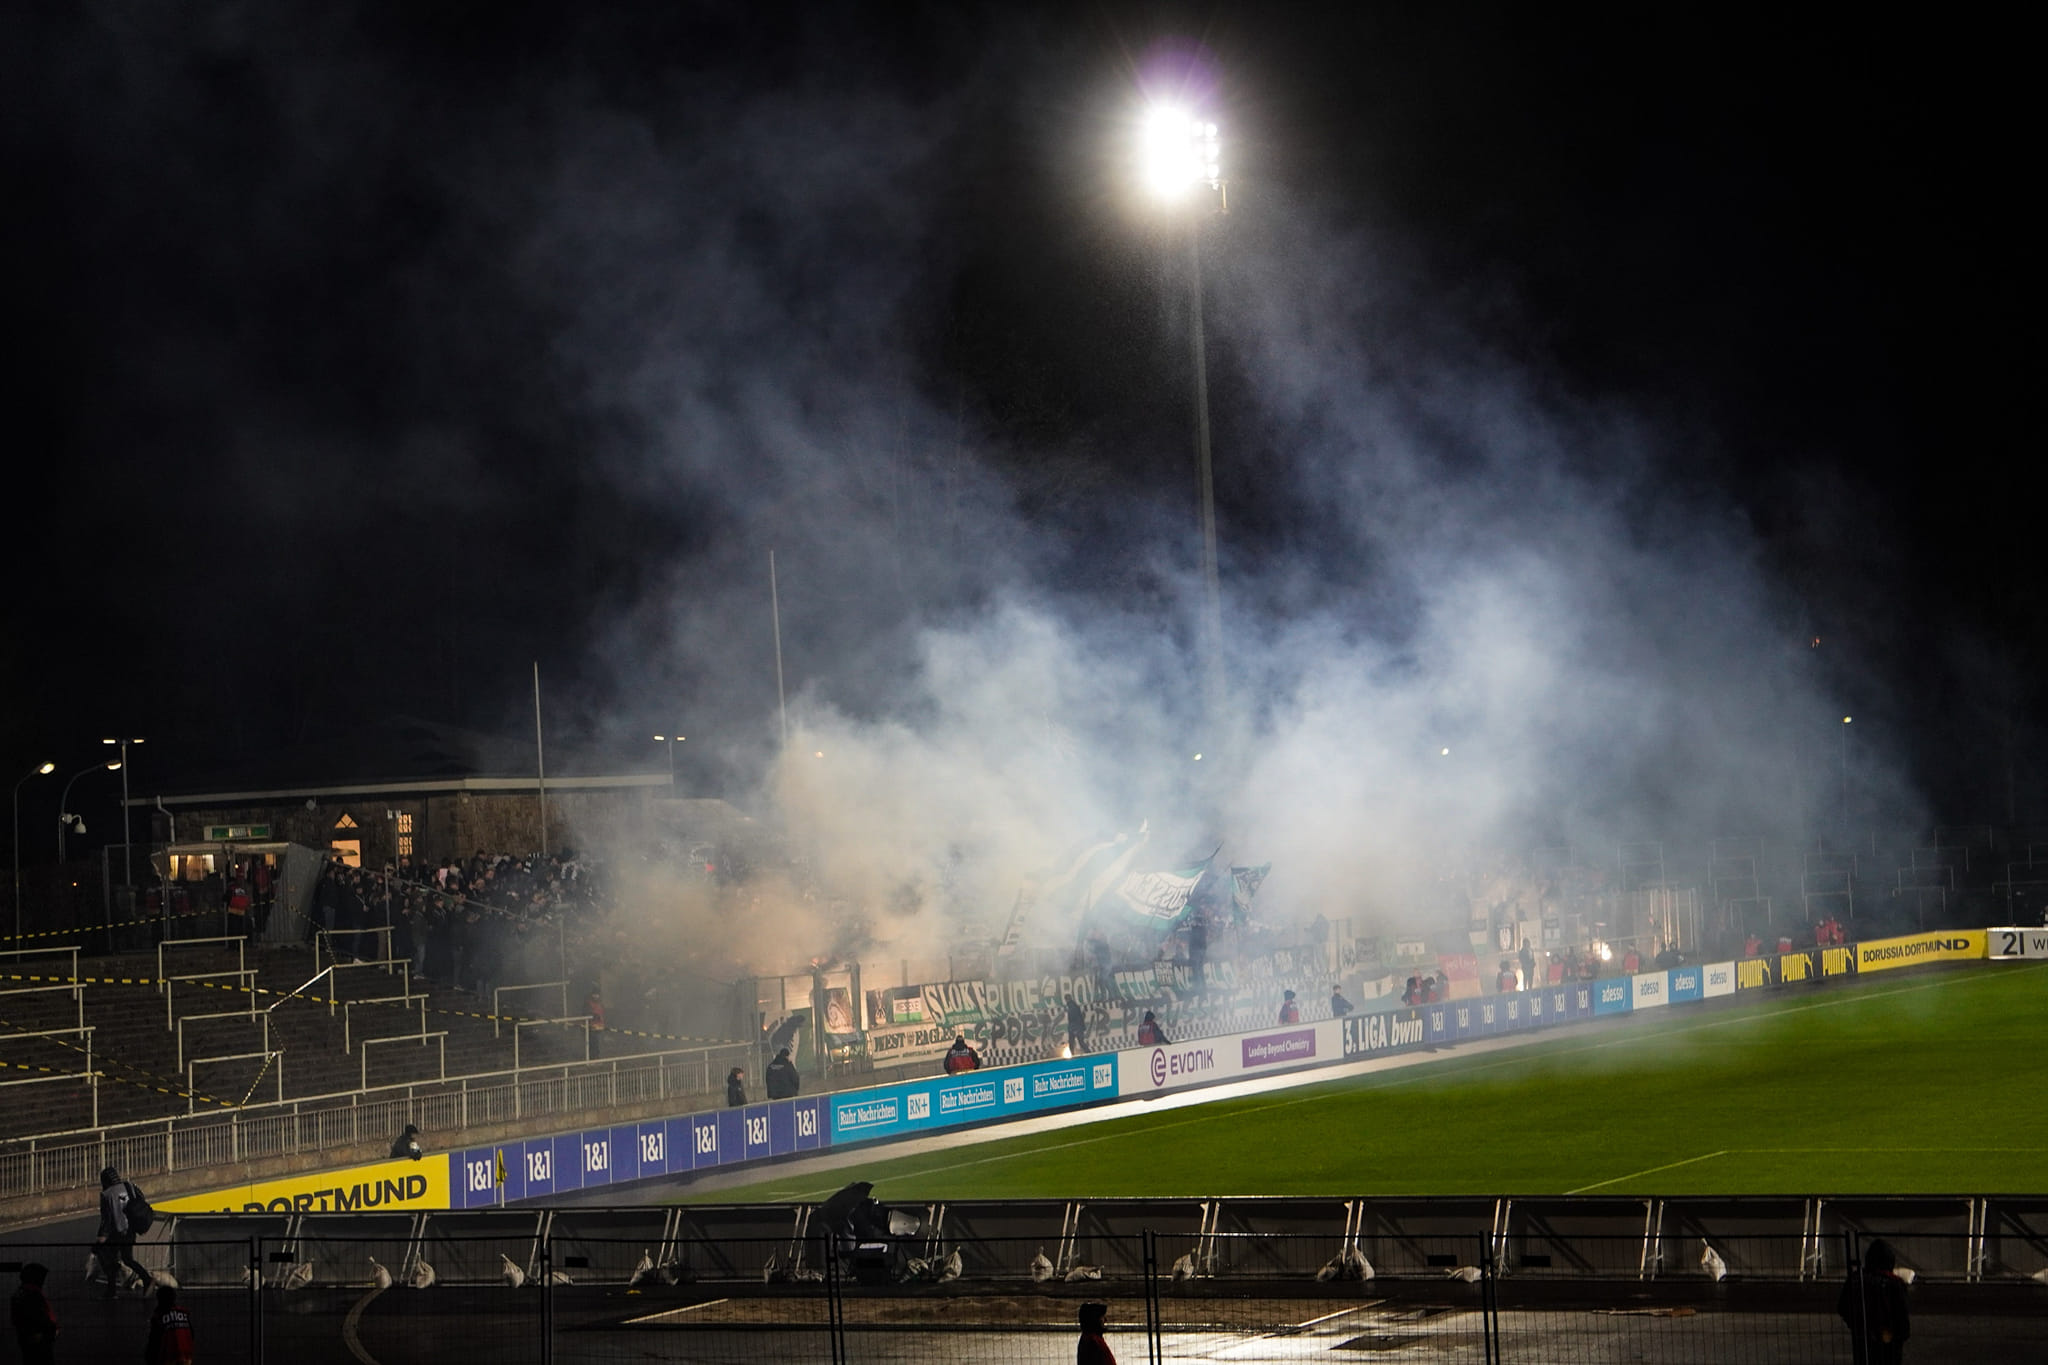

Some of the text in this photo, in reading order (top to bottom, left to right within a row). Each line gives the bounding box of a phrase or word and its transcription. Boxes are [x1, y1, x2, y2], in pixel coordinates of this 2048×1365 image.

[1863, 938, 1970, 963] BORUSSIA DORTMUND
[2002, 931, 2048, 955] 21 W
[1781, 953, 1806, 983] PUMA
[1822, 948, 1847, 977] PUMA
[1674, 975, 1696, 992] adesso
[1710, 970, 1728, 986] adesso
[1738, 959, 1763, 989] PUMA
[1578, 990, 1588, 1009] 1&1
[1602, 985, 1623, 1004] adesso
[1640, 980, 1659, 997] adesso
[1483, 1004, 1495, 1025] 1&1
[1507, 1000, 1518, 1020] 1&1
[1530, 997, 1542, 1017] 1&1
[1554, 994, 1566, 1013] 1&1
[1431, 1011, 1444, 1033] 1&1
[1457, 1007, 1470, 1028] 1&1
[874, 1032, 906, 1052] WEST
[915, 1026, 956, 1047] EAGLES
[974, 1007, 1110, 1051] SPORTCB
[1345, 1010, 1424, 1054] 3. LIGA bwin
[1248, 1038, 1310, 1058] Leading Beyond Chemistry
[1170, 1048, 1214, 1075] EVONIK
[1034, 1074, 1084, 1093] Ruhr Nachrichten
[1095, 1070, 1110, 1084] RN+
[942, 1088, 994, 1109] Ruhr Nachrichten
[1005, 1084, 1023, 1098] RN+
[839, 1104, 896, 1126] Ruhr Nachrichten
[909, 1099, 928, 1115] RN+
[746, 1116, 768, 1145] 1&1
[796, 1108, 817, 1137] 1&1
[640, 1132, 664, 1162] 1&1
[695, 1124, 717, 1154] 1&1
[527, 1150, 551, 1182] 1&1
[584, 1141, 608, 1172] 1&1
[467, 1160, 492, 1192] 1&1
